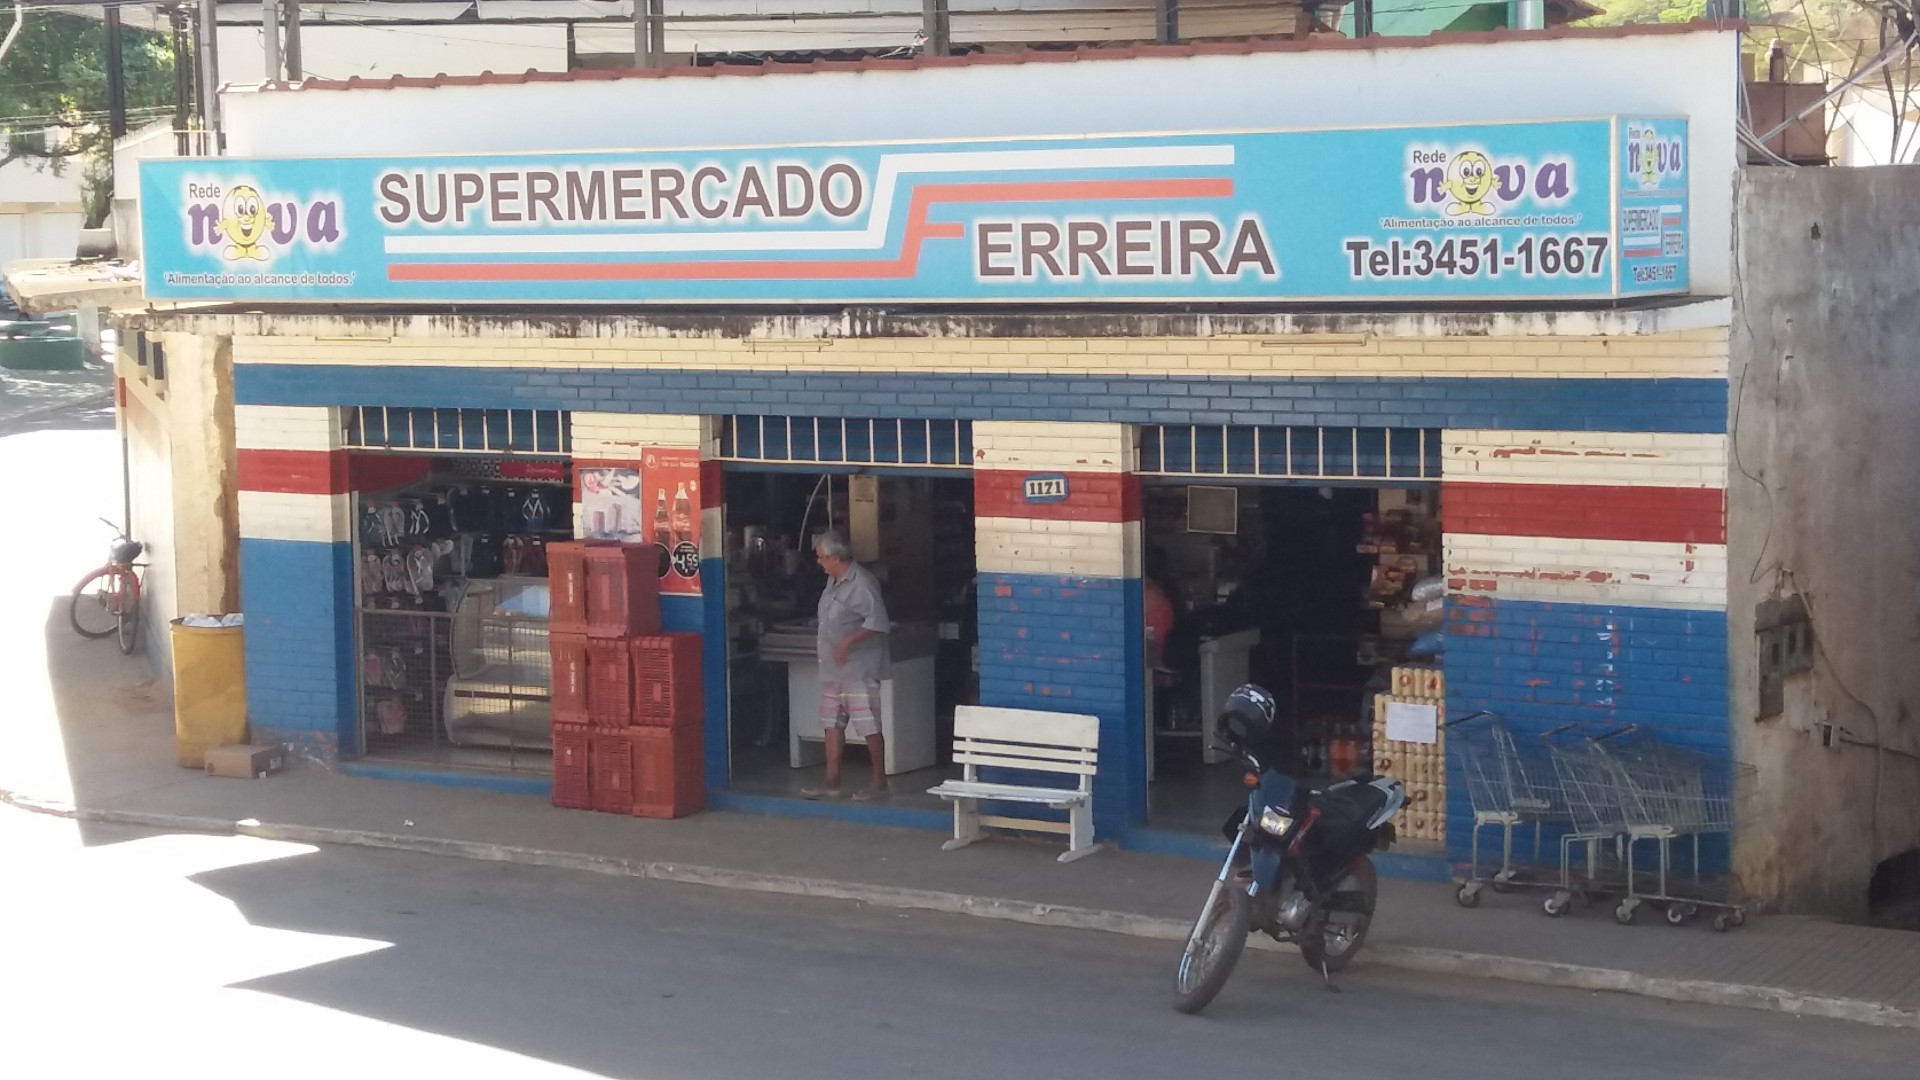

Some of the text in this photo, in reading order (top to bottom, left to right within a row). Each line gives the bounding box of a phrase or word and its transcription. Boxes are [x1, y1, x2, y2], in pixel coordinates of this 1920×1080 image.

[1413, 150, 1447, 164] Rede
[189, 183, 221, 199] Rede
[380, 164, 863, 223] SUPERMERCADO
[1457, 217, 1472, 227] ao
[1474, 216, 1521, 227] alcance
[1523, 215, 1538, 225] de
[1346, 237, 1608, 278] Tel:3451-1667
[237, 275, 251, 284] ao
[254, 272, 298, 284] alcance
[300, 272, 315, 284] de
[1029, 481, 1062, 495] 1171
